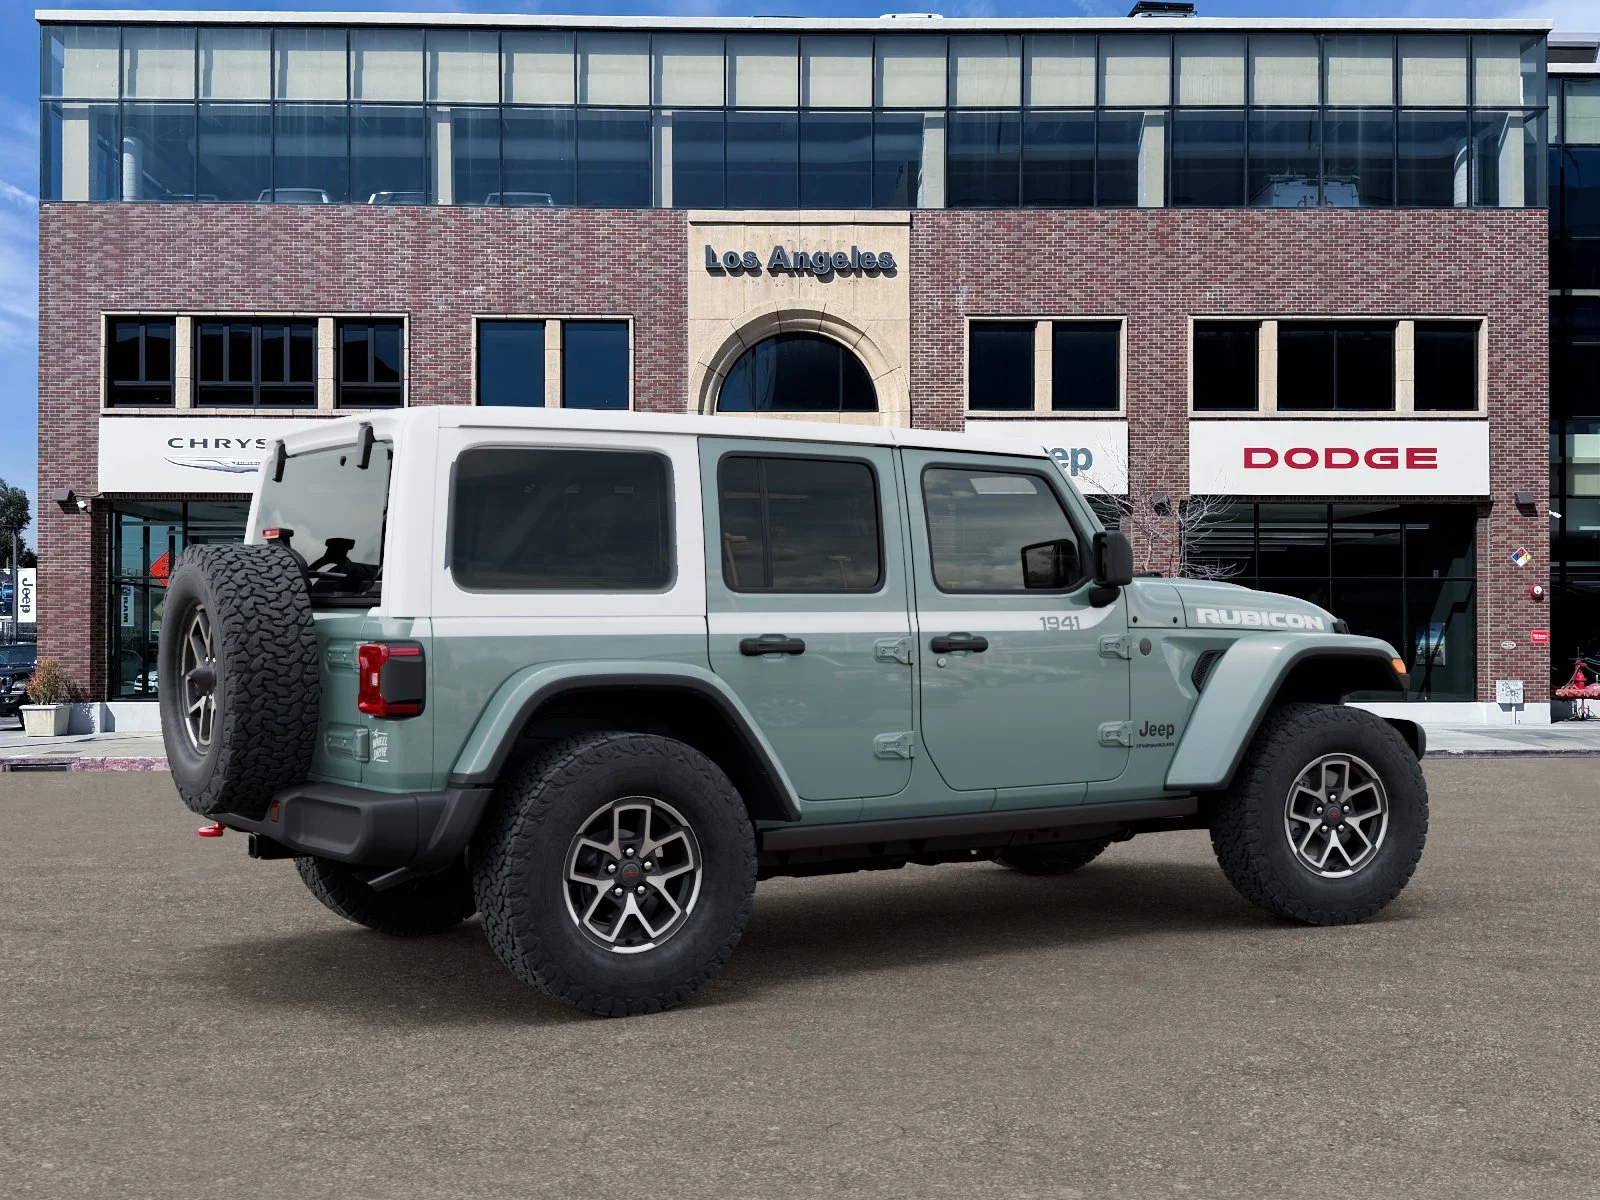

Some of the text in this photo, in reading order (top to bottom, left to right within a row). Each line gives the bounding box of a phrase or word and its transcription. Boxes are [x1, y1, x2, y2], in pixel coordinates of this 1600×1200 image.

[704, 244, 895, 276] Los Angeles
[1243, 447, 1438, 469] DODGE
[20, 577, 34, 614] Jeep
[1039, 615, 1081, 631] 1941
[1196, 607, 1325, 631] RUBICON
[1138, 720, 1175, 739] Jeep
[372, 736, 388, 750] WHEEL
